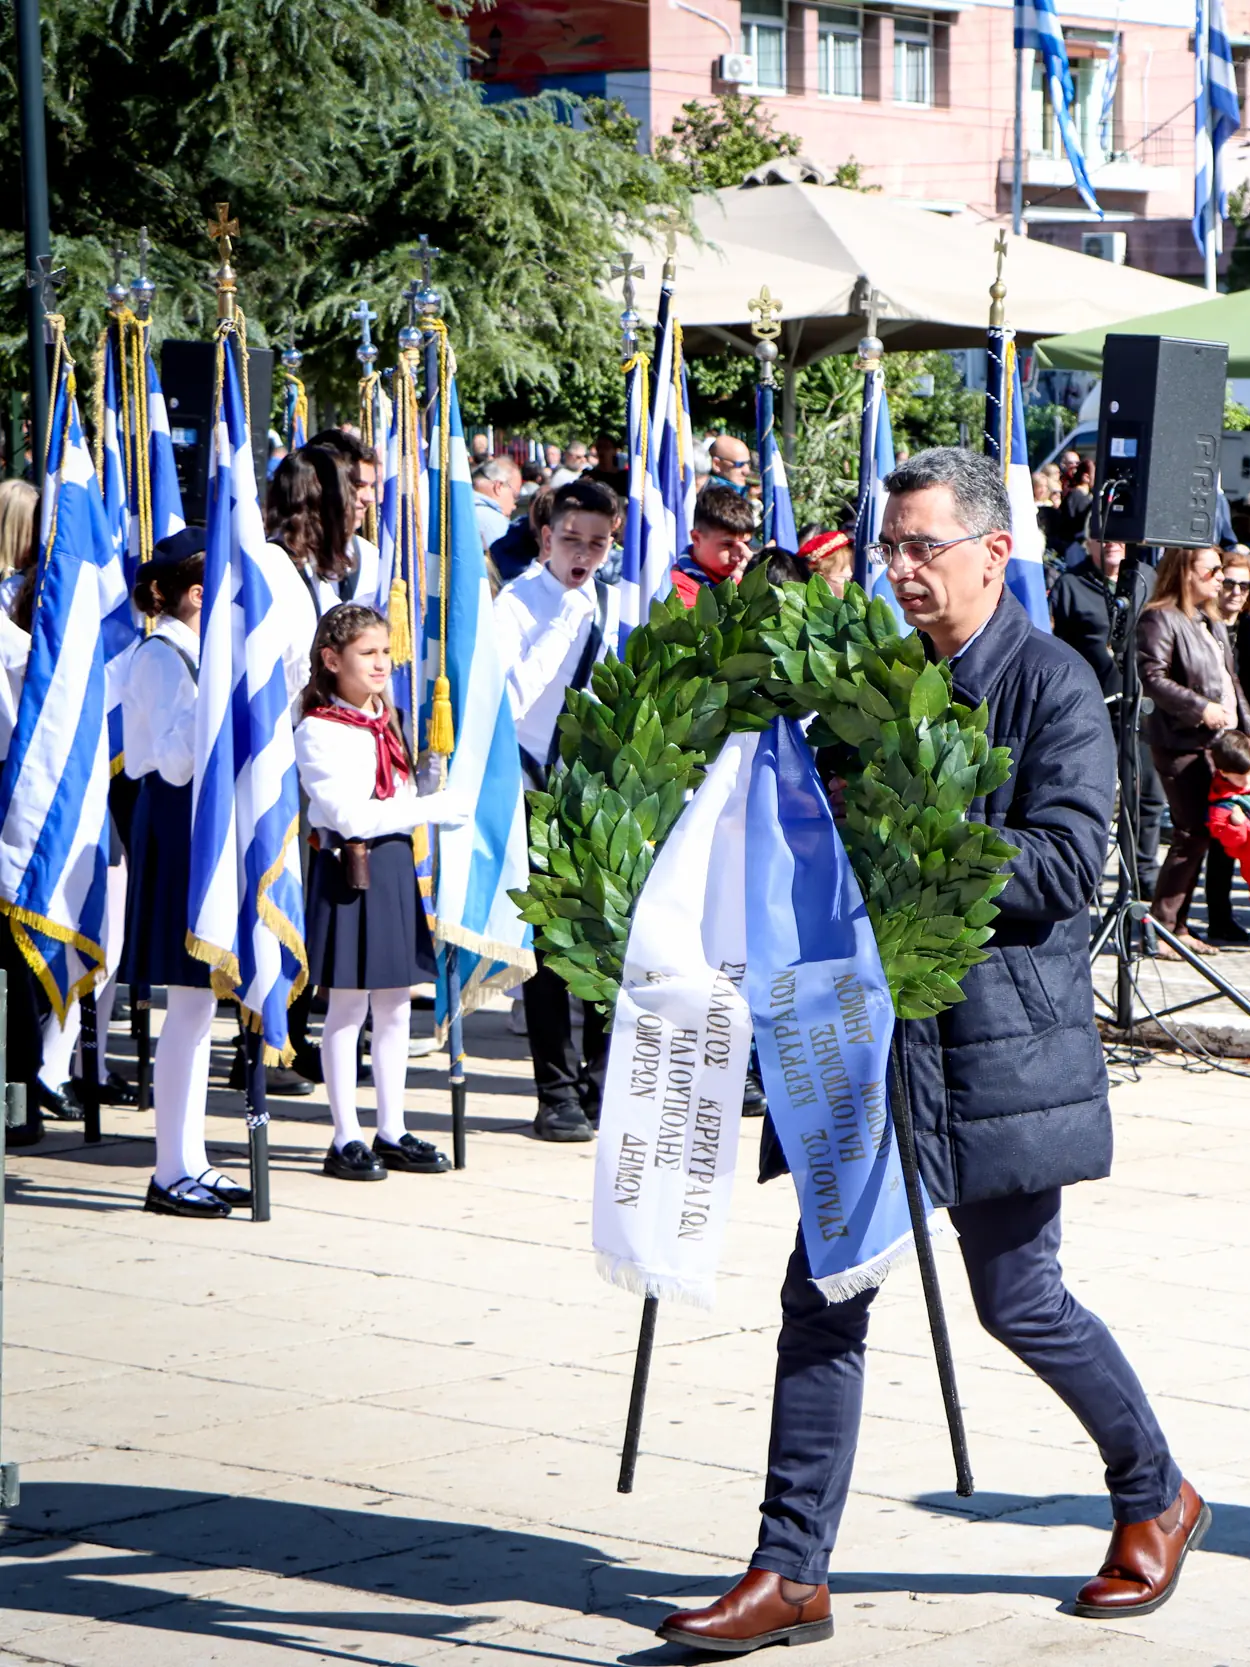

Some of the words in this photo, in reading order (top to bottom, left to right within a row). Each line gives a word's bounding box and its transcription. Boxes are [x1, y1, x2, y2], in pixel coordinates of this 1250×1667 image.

[630, 1013, 663, 1101] ΟΜΟΡΩΝ
[704, 960, 746, 1070] ΣΥΛΛΟΓΟΣ
[770, 970, 819, 1110] ΚΕΡΚΥΡΑΙΩΝ
[833, 972, 876, 1045] ΔΗΜΩΝ
[654, 1028, 698, 1172] ΗΛΙΟΥΠΟΛΗΣ
[809, 1023, 866, 1163] ΗΛΙΟΥΠΟΛΗΣ
[614, 1132, 648, 1209] ΔΗΜΩΝ
[677, 1096, 723, 1241] ΚΕΡΚΥΡΑΙΩΝ
[801, 1128, 850, 1243] ΣΥΛΛΟΓΟΣ
